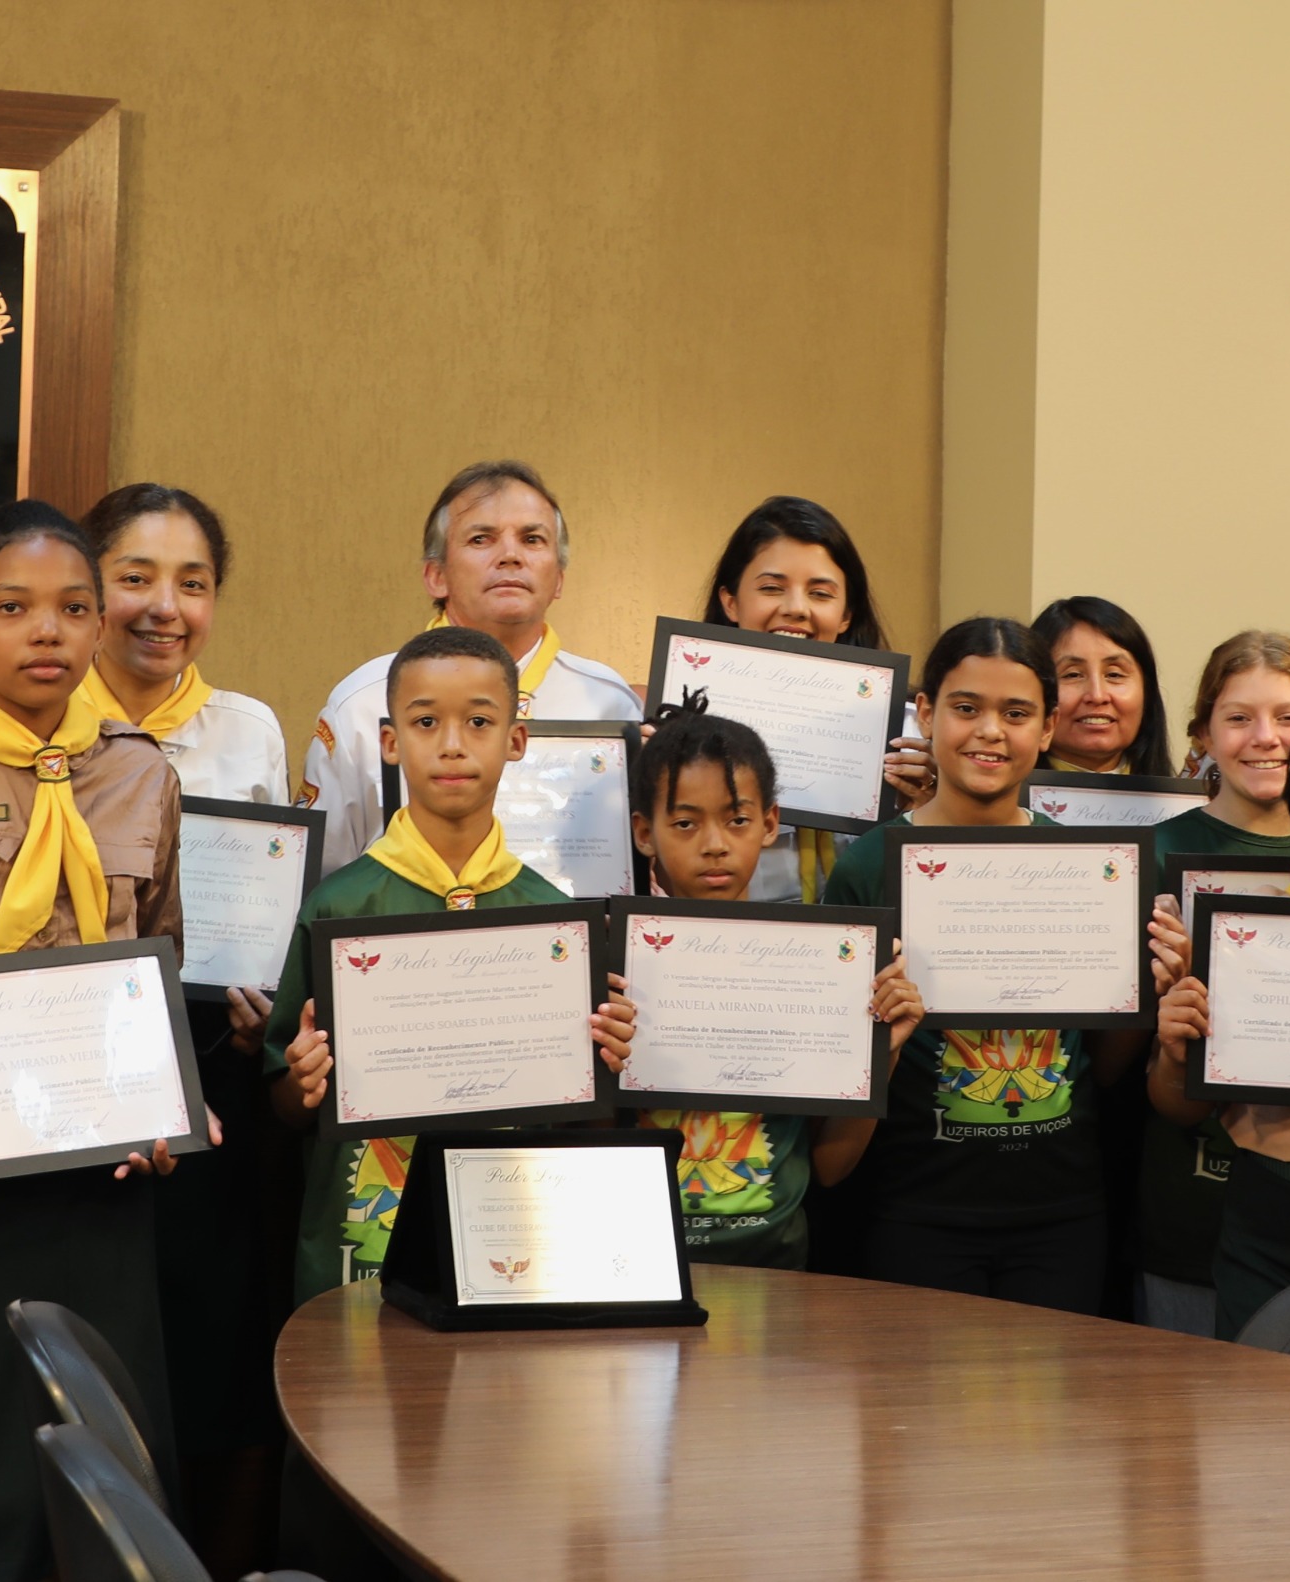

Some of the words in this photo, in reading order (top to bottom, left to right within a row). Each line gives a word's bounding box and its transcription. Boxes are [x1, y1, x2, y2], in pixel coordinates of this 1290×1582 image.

[716, 660, 758, 679] Poder
[764, 667, 845, 692] Legislativo
[748, 718, 775, 728] LIMA
[778, 722, 813, 733] COSTA
[816, 728, 871, 743] MACHADO
[1073, 805, 1111, 821] Poder
[1119, 808, 1174, 825] Legislat
[951, 861, 999, 879] Poder
[1005, 861, 1091, 889] Legislativo
[187, 891, 244, 904] MARENGO
[248, 896, 279, 907] LUNA
[938, 924, 966, 933] LARA
[969, 924, 1035, 934] BERNARDES
[1038, 925, 1072, 934] SALES
[1075, 925, 1110, 934] LOPES
[388, 949, 440, 971] Poder
[445, 943, 536, 972] Legislativo
[679, 935, 727, 953] Poder
[735, 937, 825, 965] Legislativo
[657, 999, 715, 1010] MANUELA
[719, 1002, 773, 1013] MIRANDA
[777, 1004, 815, 1014] VIEIRA
[818, 1006, 848, 1016] BRAZ
[352, 1024, 398, 1036] MAYCON
[401, 1021, 435, 1033] LUCAS
[437, 1018, 477, 1031] SOARES
[480, 1016, 494, 1027] DA
[497, 1014, 525, 1025] SILVA
[528, 1010, 580, 1023] MACHADO
[10, 1054, 67, 1072] MIRANDA
[68, 1049, 109, 1064] VIEIRA
[933, 1108, 1008, 1141] LUZEIROS
[1013, 1125, 1031, 1136] DE
[1037, 1117, 1072, 1134] VIÇOSA
[998, 1142, 1029, 1151] 2024
[485, 1165, 529, 1183] Poder
[469, 1224, 496, 1232] CLUBE
[692, 1217, 712, 1227] DE
[715, 1217, 769, 1229] VIÇOSA
[686, 1235, 710, 1244] 024
